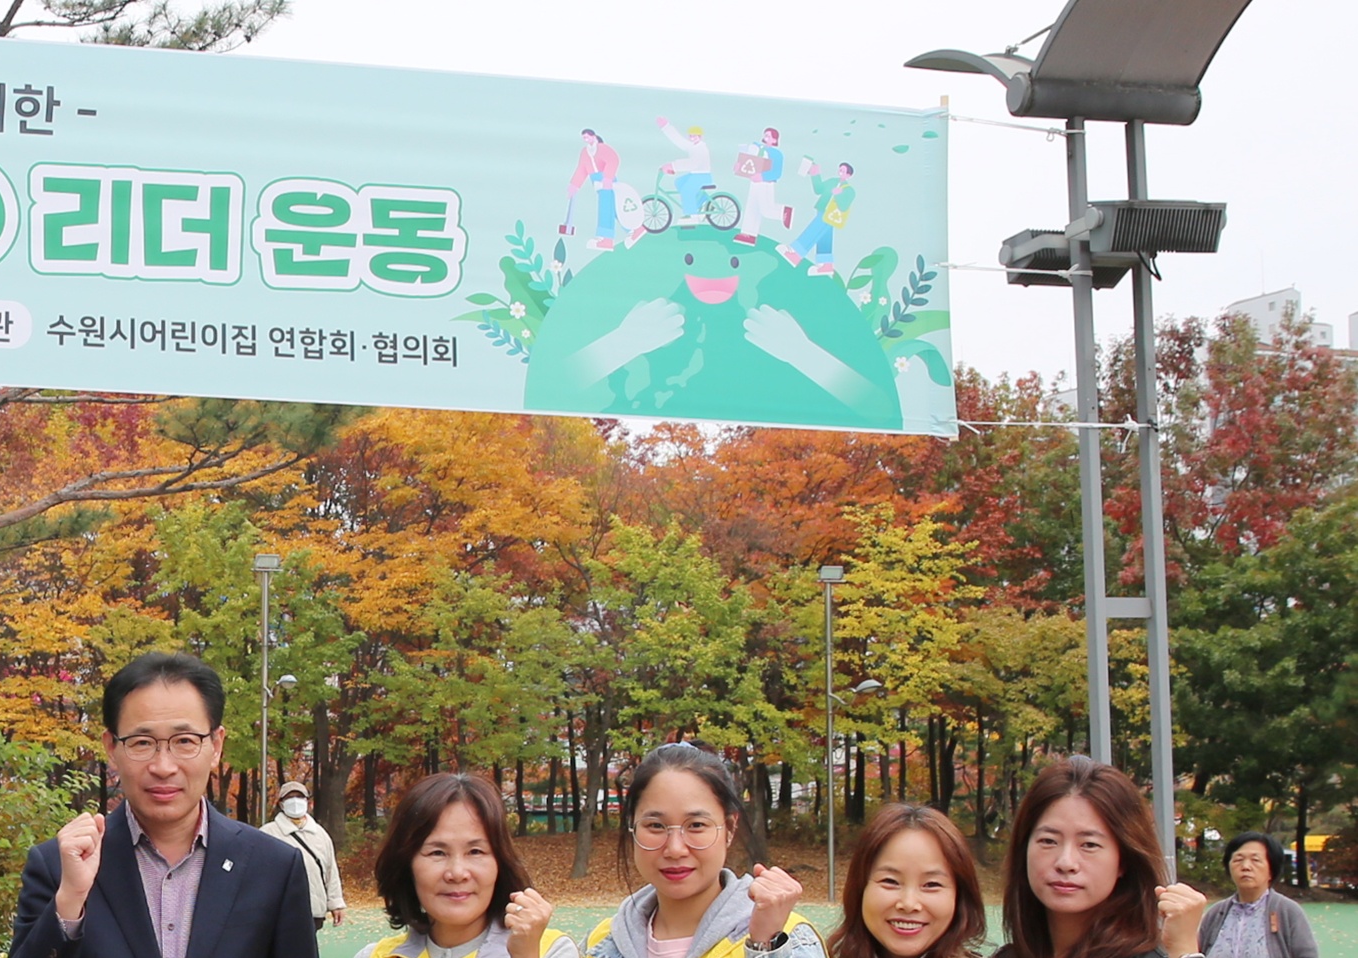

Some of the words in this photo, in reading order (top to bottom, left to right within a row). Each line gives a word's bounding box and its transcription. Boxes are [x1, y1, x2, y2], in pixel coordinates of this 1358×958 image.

[41, 176, 234, 274] 리더
[262, 189, 456, 286] 운동
[46, 315, 257, 356] 수원시어린이집
[268, 327, 457, 368] 연합회·협의회
